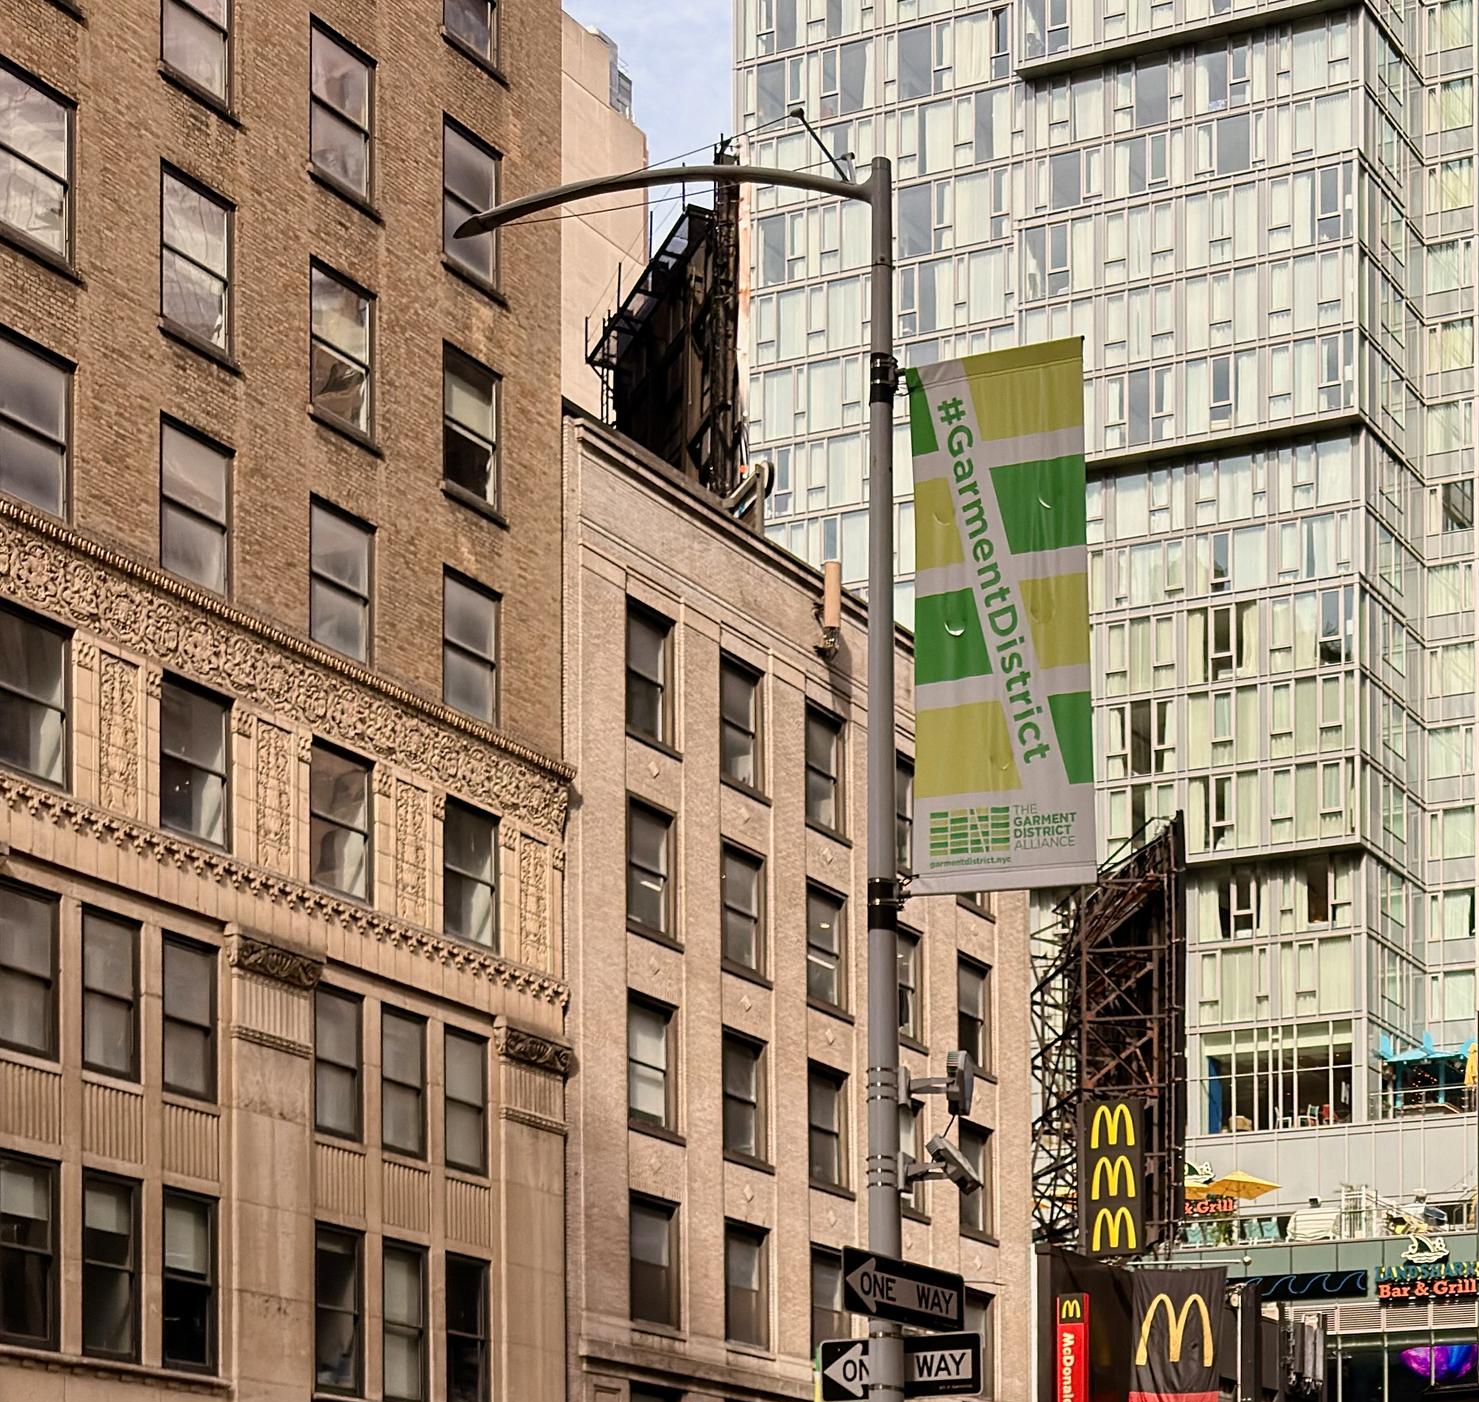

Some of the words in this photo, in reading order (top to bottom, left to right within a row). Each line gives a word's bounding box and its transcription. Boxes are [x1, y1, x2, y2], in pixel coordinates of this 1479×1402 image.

[938, 397, 1050, 764] #GarmentDistrict
[1013, 804, 1038, 815] THE
[1013, 812, 1077, 827] GARMENT
[1014, 824, 1072, 839] DISTRICT
[1014, 836, 1076, 850] ALLIANCE
[929, 856, 1012, 869] garmentdistrict.nyc
[1196, 1198, 1234, 1214] Grill
[1375, 1262, 1479, 1281] LANDSHARK
[859, 1271, 897, 1302] ONE
[916, 1284, 954, 1315] WAY
[1378, 1283, 1411, 1299] Bar
[1414, 1281, 1429, 1296] &
[1432, 1278, 1477, 1295] Grill
[842, 1358, 869, 1382] ON
[915, 1352, 966, 1378] WAY
